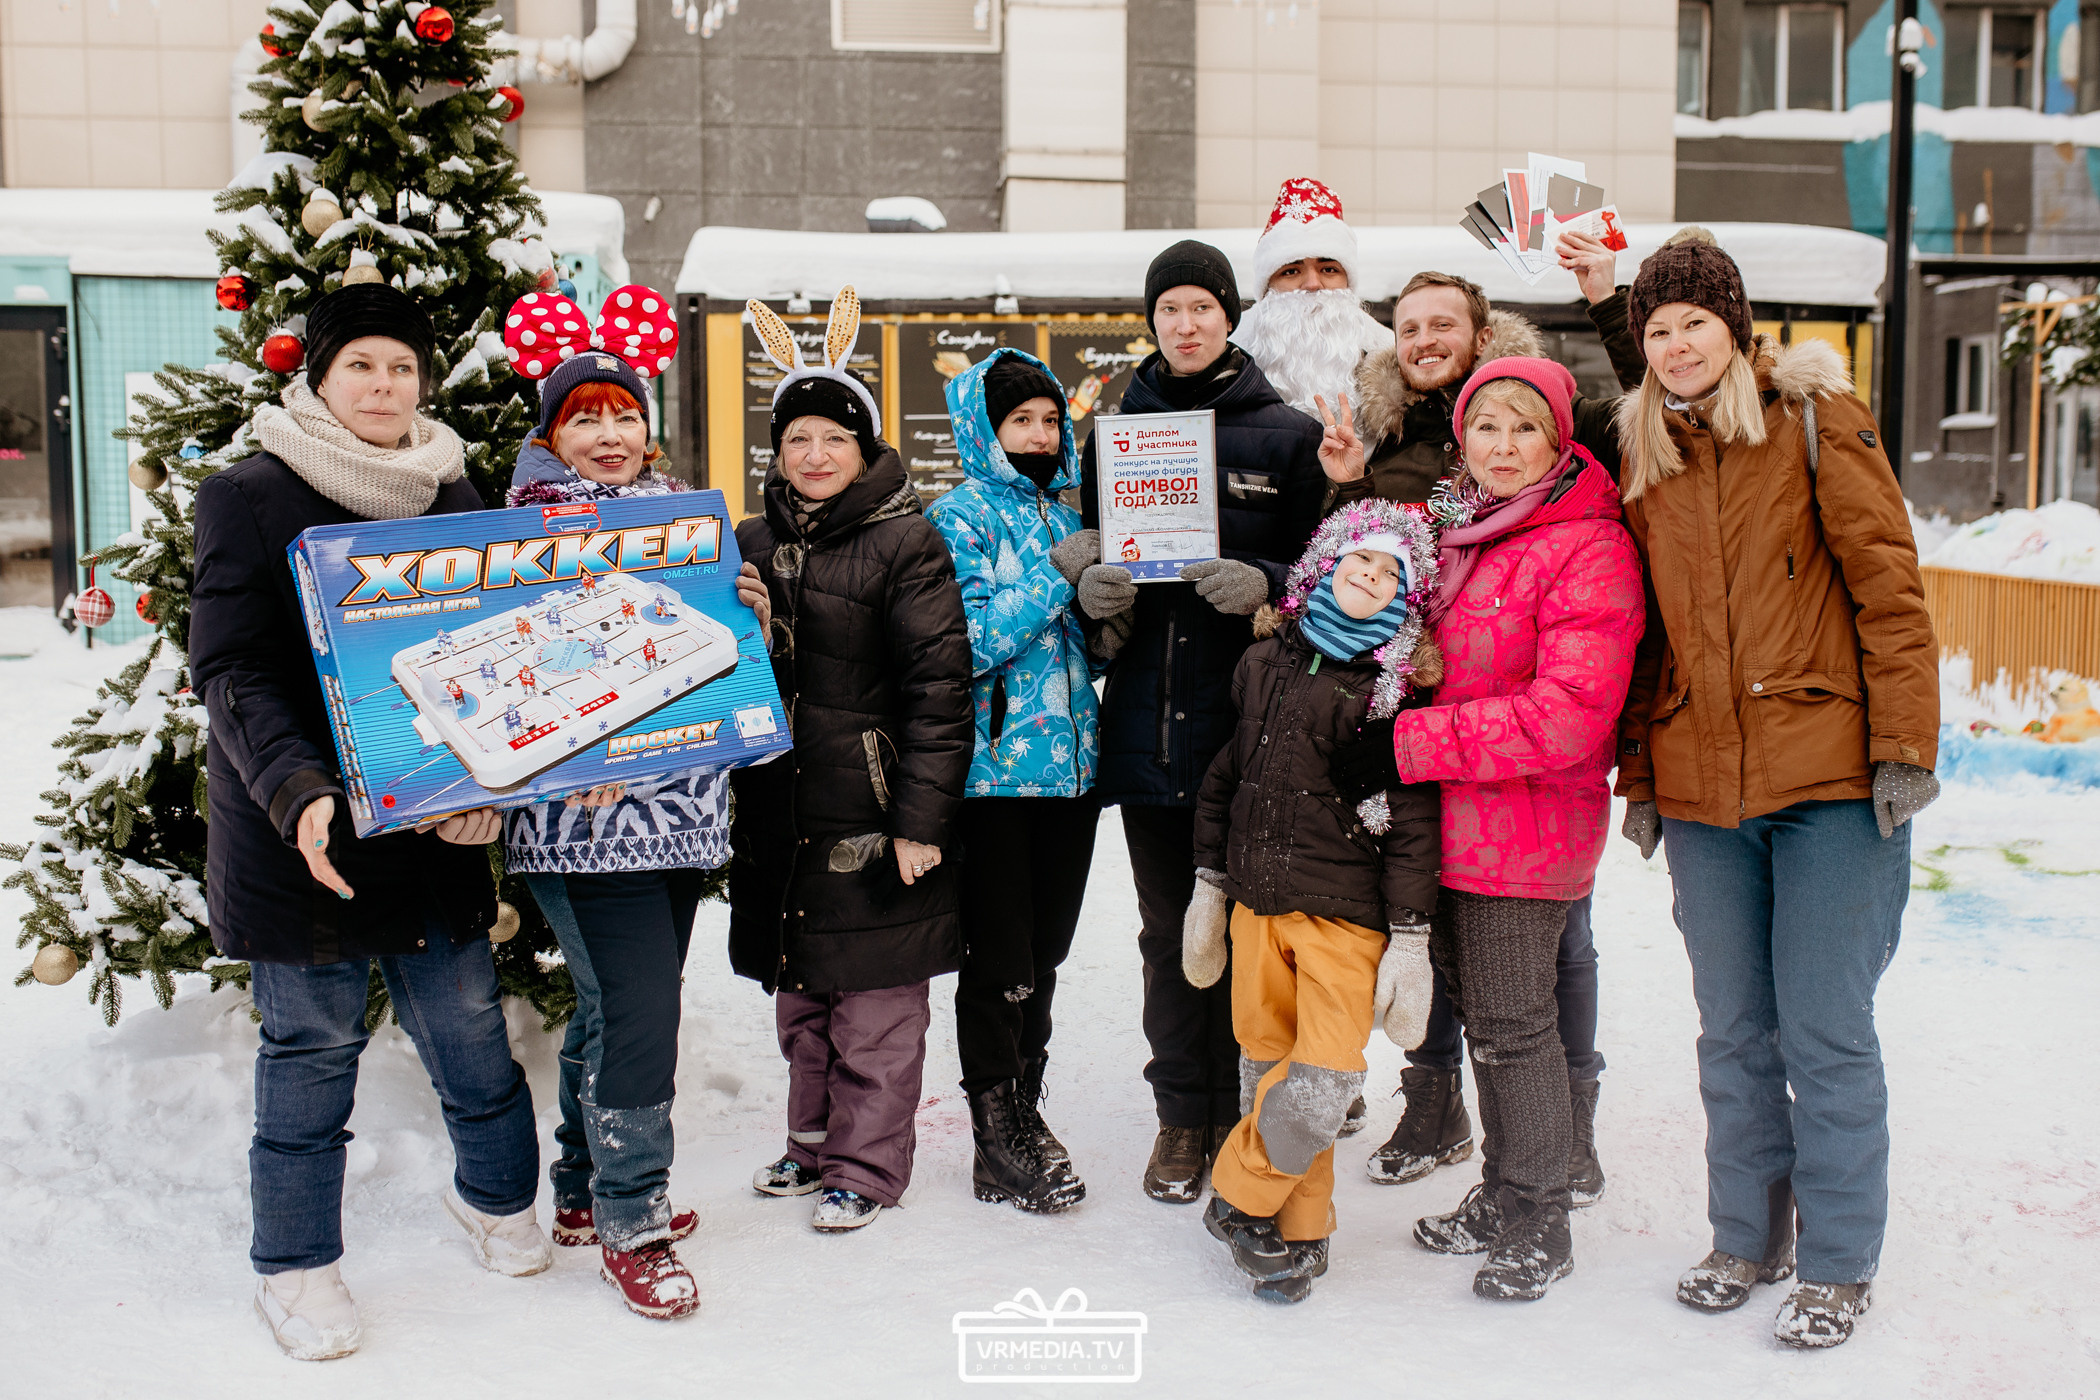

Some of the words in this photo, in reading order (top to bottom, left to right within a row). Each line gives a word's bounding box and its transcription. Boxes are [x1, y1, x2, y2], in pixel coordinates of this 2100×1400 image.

[1136, 429, 1180, 440] Диплом
[1136, 439, 1198, 452] участника
[1113, 459, 1149, 468] конкурс
[1162, 456, 1199, 466] лучшую
[1113, 468, 1160, 478] снежную
[1161, 466, 1198, 477] фигуру
[1113, 476, 1198, 495] СИМВОЛ
[1114, 494, 1157, 510] ГОДА
[1160, 492, 1199, 506] 2022
[337, 514, 723, 608] ХОККЕЙ
[662, 565, 720, 580] OMZET.RU
[343, 600, 442, 624] НАСТОЛЬНАЯ
[442, 596, 482, 613] ИГРА
[607, 719, 725, 758] HOCKEY
[604, 753, 638, 765] SPORTING
[642, 749, 663, 759] GAME
[667, 746, 681, 755] FOR
[686, 739, 719, 751] CHILDREN
